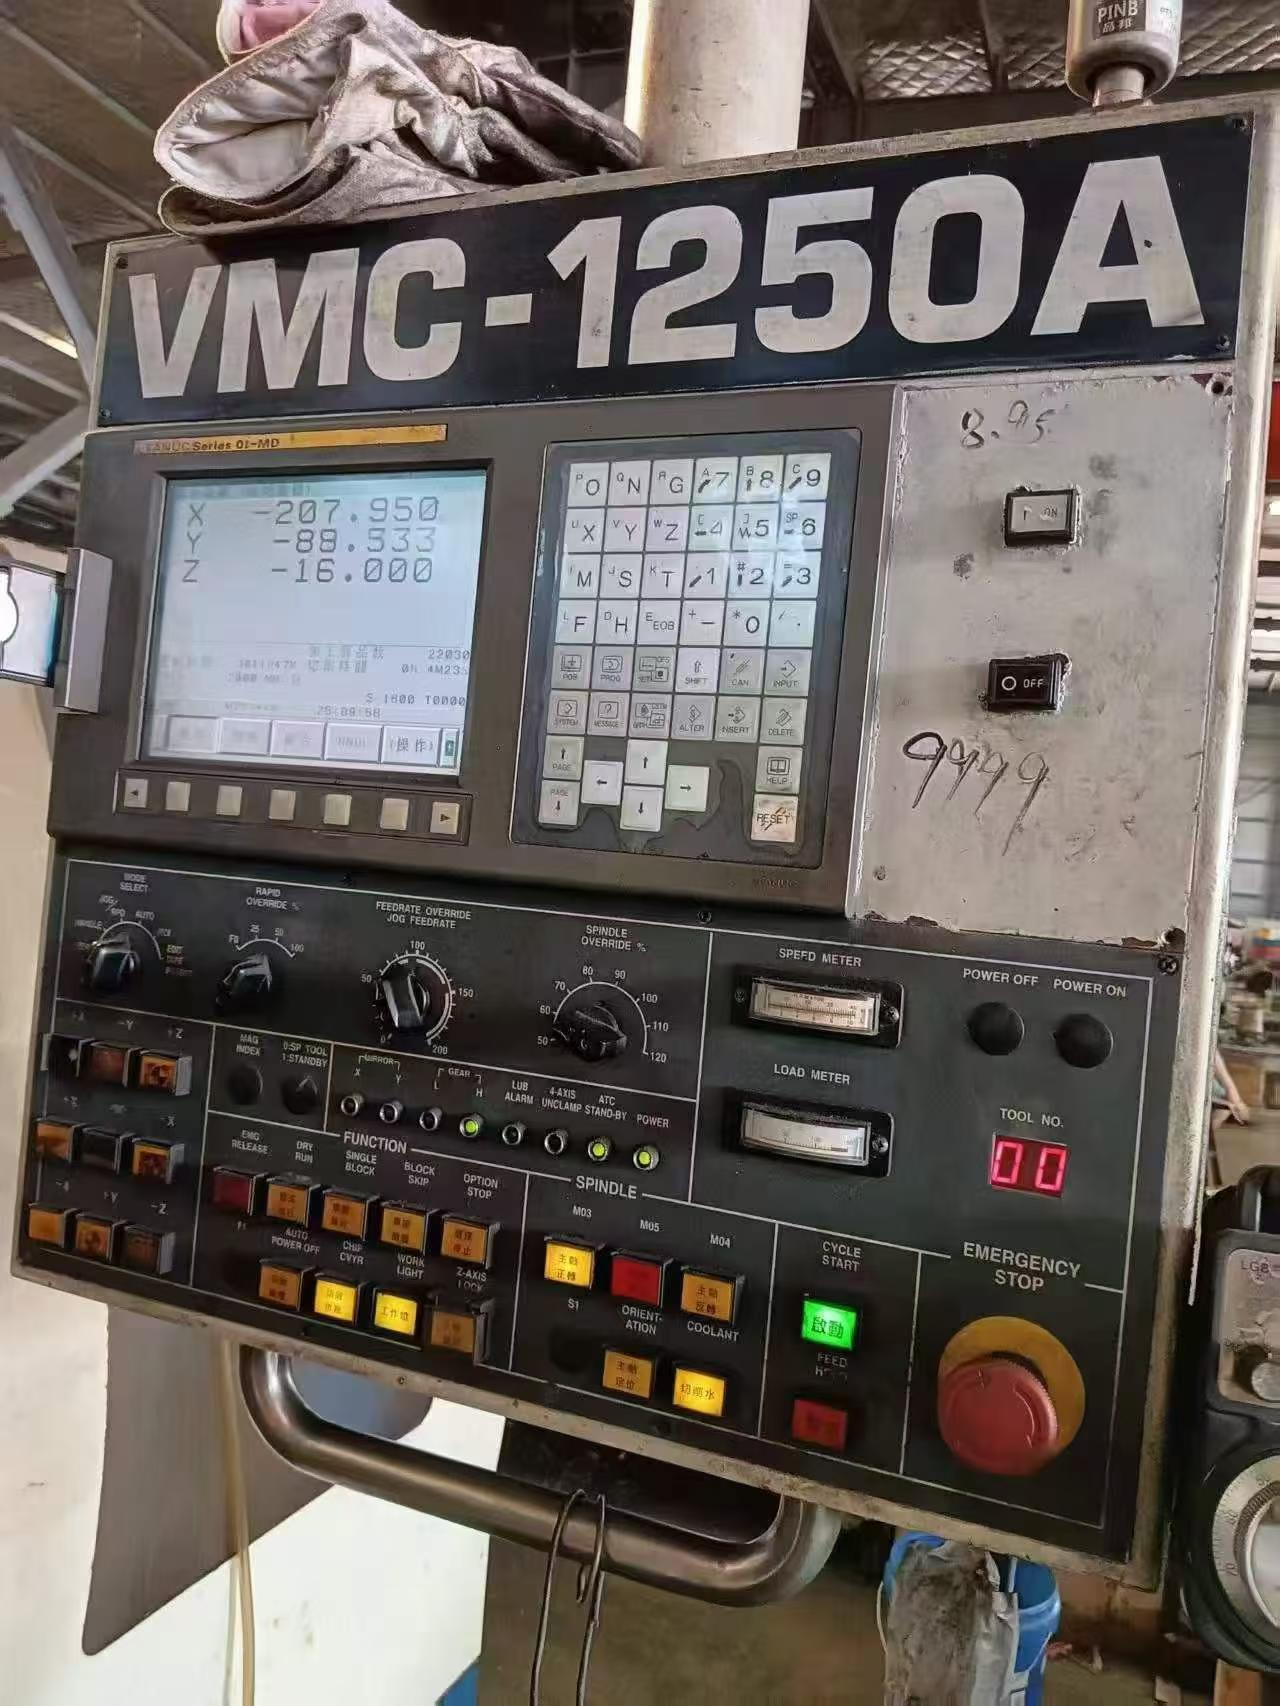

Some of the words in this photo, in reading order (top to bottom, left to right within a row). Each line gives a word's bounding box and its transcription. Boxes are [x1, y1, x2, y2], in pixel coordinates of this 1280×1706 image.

[128, 155, 1205, 400] VMC-1250A
[192, 440, 232, 451] Series
[627, 477, 641, 494] N
[669, 476, 684, 494] G
[716, 471, 730, 488] 7
[759, 470, 774, 488] 8
[806, 469, 821, 487] 9
[188, 503, 205, 526] X
[254, 497, 440, 526] -207.950
[582, 525, 596, 542] X
[624, 524, 638, 541] Y
[665, 523, 679, 541] Z
[754, 519, 769, 537] 5
[801, 518, 816, 536] 6
[186, 531, 202, 553] Y
[182, 560, 200, 582] Z
[271, 557, 433, 583] -16.000
[706, 567, 715, 585] 1
[749, 567, 764, 585] 2
[796, 567, 811, 585] 3
[577, 570, 592, 588] M
[618, 570, 633, 588] S
[661, 570, 676, 588] T
[574, 615, 588, 633] F
[615, 616, 628, 633] H
[1023, 678, 1044, 689] OFF
[679, 724, 705, 733] ALTER
[767, 728, 796, 737] DELETE
[756, 812, 790, 826] RESET
[255, 886, 281, 897] RAPID
[246, 896, 288, 910] OVERRIDE
[376, 901, 421, 915] FEEDRATE
[425, 906, 472, 920] OVERRIDE
[387, 914, 406, 924] JOG
[409, 915, 457, 929] FEEDRATE
[586, 924, 628, 938] SPINDLE
[581, 935, 632, 951] OVERRIDE
[822, 953, 862, 967] METER
[614, 969, 626, 980] 90
[963, 968, 1009, 983] POWER
[1013, 974, 1039, 986] OFF
[458, 988, 474, 998] 150
[554, 981, 566, 991] 70
[1053, 979, 1102, 994] POWER
[1106, 985, 1127, 997] ON
[641, 992, 658, 1004] 100
[306, 1045, 328, 1056] TOOL
[650, 1051, 667, 1063] 120
[448, 1067, 471, 1078] GEAR
[774, 1063, 805, 1078] LOAD
[811, 1070, 851, 1085] METER
[476, 1087, 483, 1097] H
[511, 1080, 529, 1091] LUB
[549, 1086, 577, 1099] 4-AXIS
[504, 1092, 534, 1105] ALARM
[542, 1098, 582, 1113] UNCLAMP
[598, 1094, 616, 1106] ATC
[584, 1104, 628, 1121] STAND-BY
[1000, 1108, 1034, 1123] TOOL
[1041, 1115, 1064, 1128] NO.
[636, 1113, 670, 1129] POWER
[231, 1139, 268, 1154] RELEASE
[296, 1141, 314, 1151] DRY
[343, 1131, 407, 1154] FUNCTION
[295, 1152, 313, 1163] RUN
[345, 1150, 377, 1165] SINGLE
[345, 1162, 376, 1176] BLOCK
[404, 1162, 436, 1176] BLOCK
[408, 1174, 430, 1187] SKIP
[463, 1173, 499, 1190] OPTION
[575, 1175, 638, 1199] SPINDLE
[467, 1186, 492, 1200] STOP
[572, 1206, 593, 1218] M03
[639, 1219, 661, 1232] M05
[285, 1228, 308, 1240] AUTO
[709, 1233, 732, 1248] M04
[271, 1236, 301, 1249] POWER
[822, 1241, 862, 1259] CYCLE
[397, 1252, 425, 1268] WORK
[821, 1255, 861, 1272] START
[963, 1241, 1081, 1279] EMERGENCY
[396, 1265, 424, 1280] LIGHT
[456, 1266, 488, 1281] Z-AXIS
[994, 1269, 1045, 1293] STOP
[567, 1298, 579, 1310] S1
[621, 1304, 663, 1322] ORIENT-
[625, 1319, 657, 1335] ATION
[687, 1319, 740, 1342] COOLANT
[817, 1352, 848, 1368] FEED
